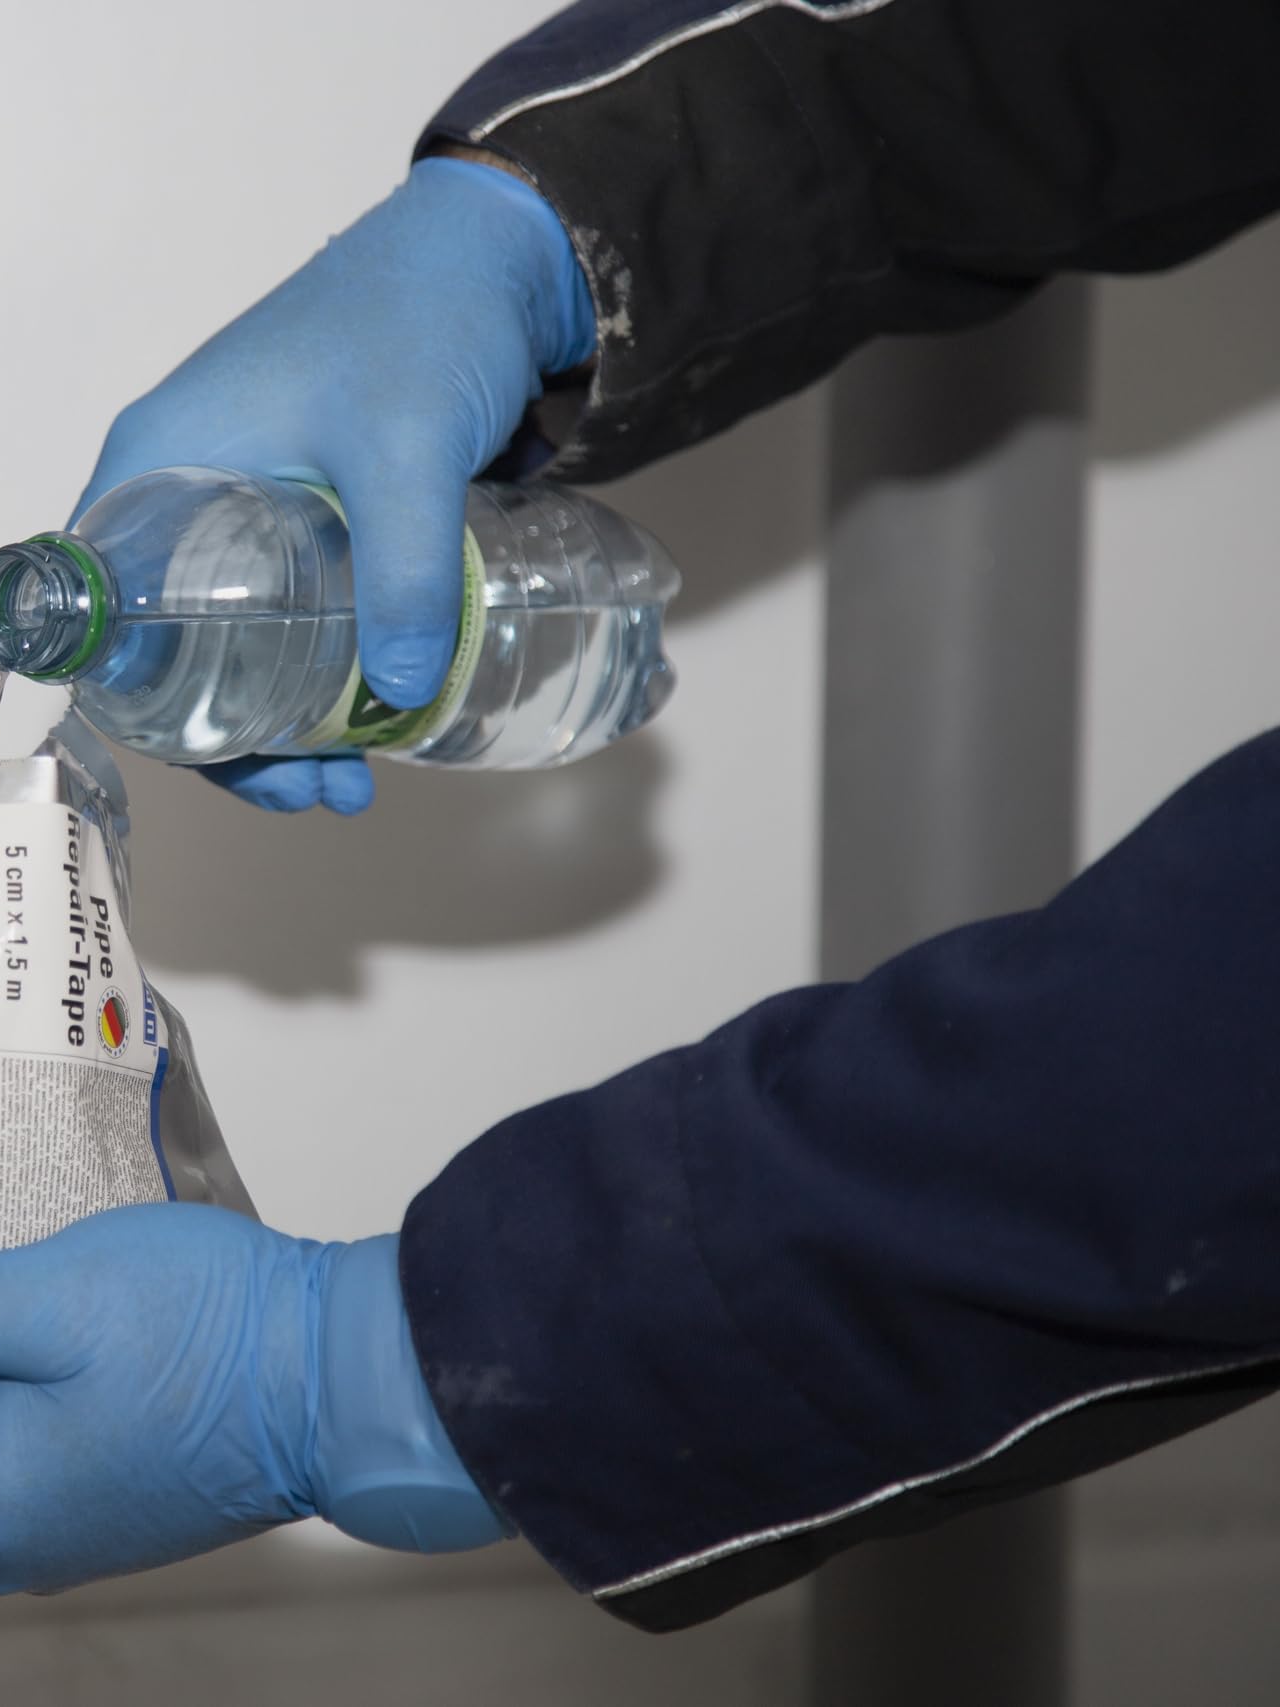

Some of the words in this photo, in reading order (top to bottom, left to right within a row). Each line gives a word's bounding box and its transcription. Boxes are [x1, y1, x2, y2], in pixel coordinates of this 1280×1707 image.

[5, 846, 28, 857] 5
[6, 868, 23, 902] cm
[7, 911, 23, 925] x
[61, 812, 91, 1047] Repair-Tape
[5, 936, 28, 971] 1,5
[89, 895, 113, 979] Pipe
[6, 980, 22, 1001] m
